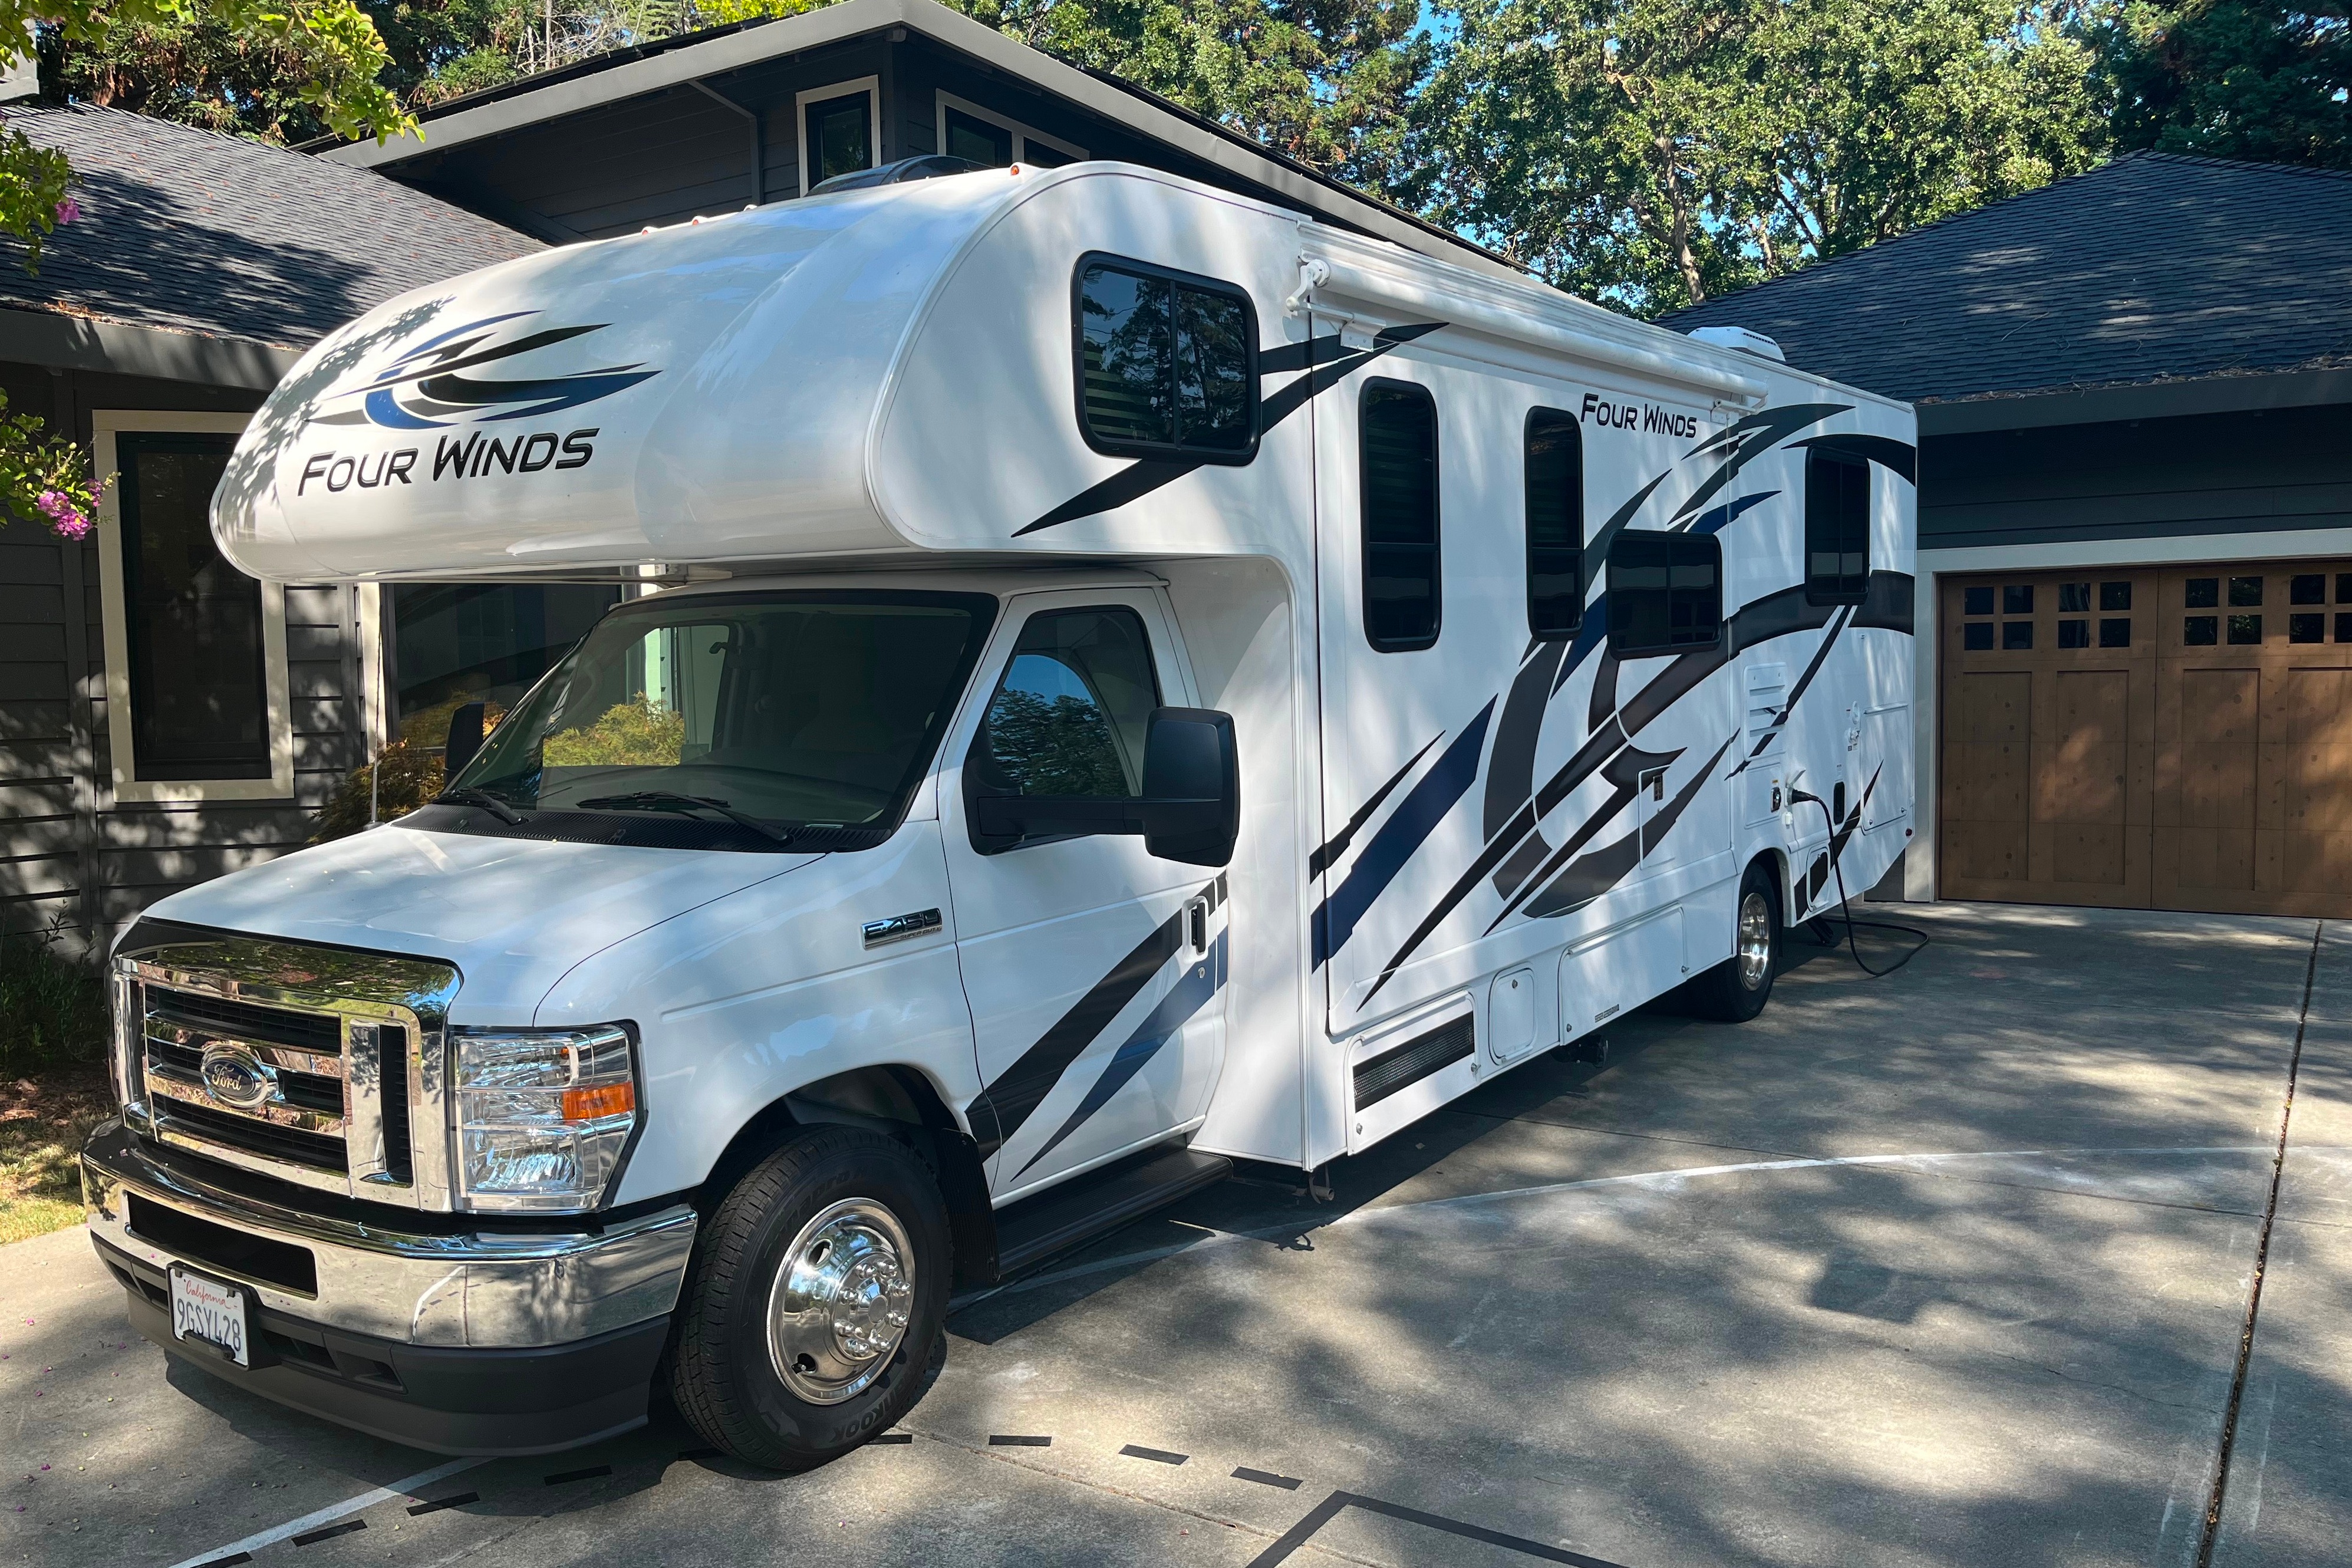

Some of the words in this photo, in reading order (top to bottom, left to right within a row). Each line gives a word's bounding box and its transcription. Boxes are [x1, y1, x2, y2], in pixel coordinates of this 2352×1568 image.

[1580, 393, 1638, 431] FOUR
[1644, 403, 1697, 439] WINDS
[297, 448, 419, 496] FOUR
[433, 427, 600, 482] WINDS
[900, 930, 922, 940] SUPER
[212, 1063, 242, 1091] Ford
[186, 1279, 231, 1310] California
